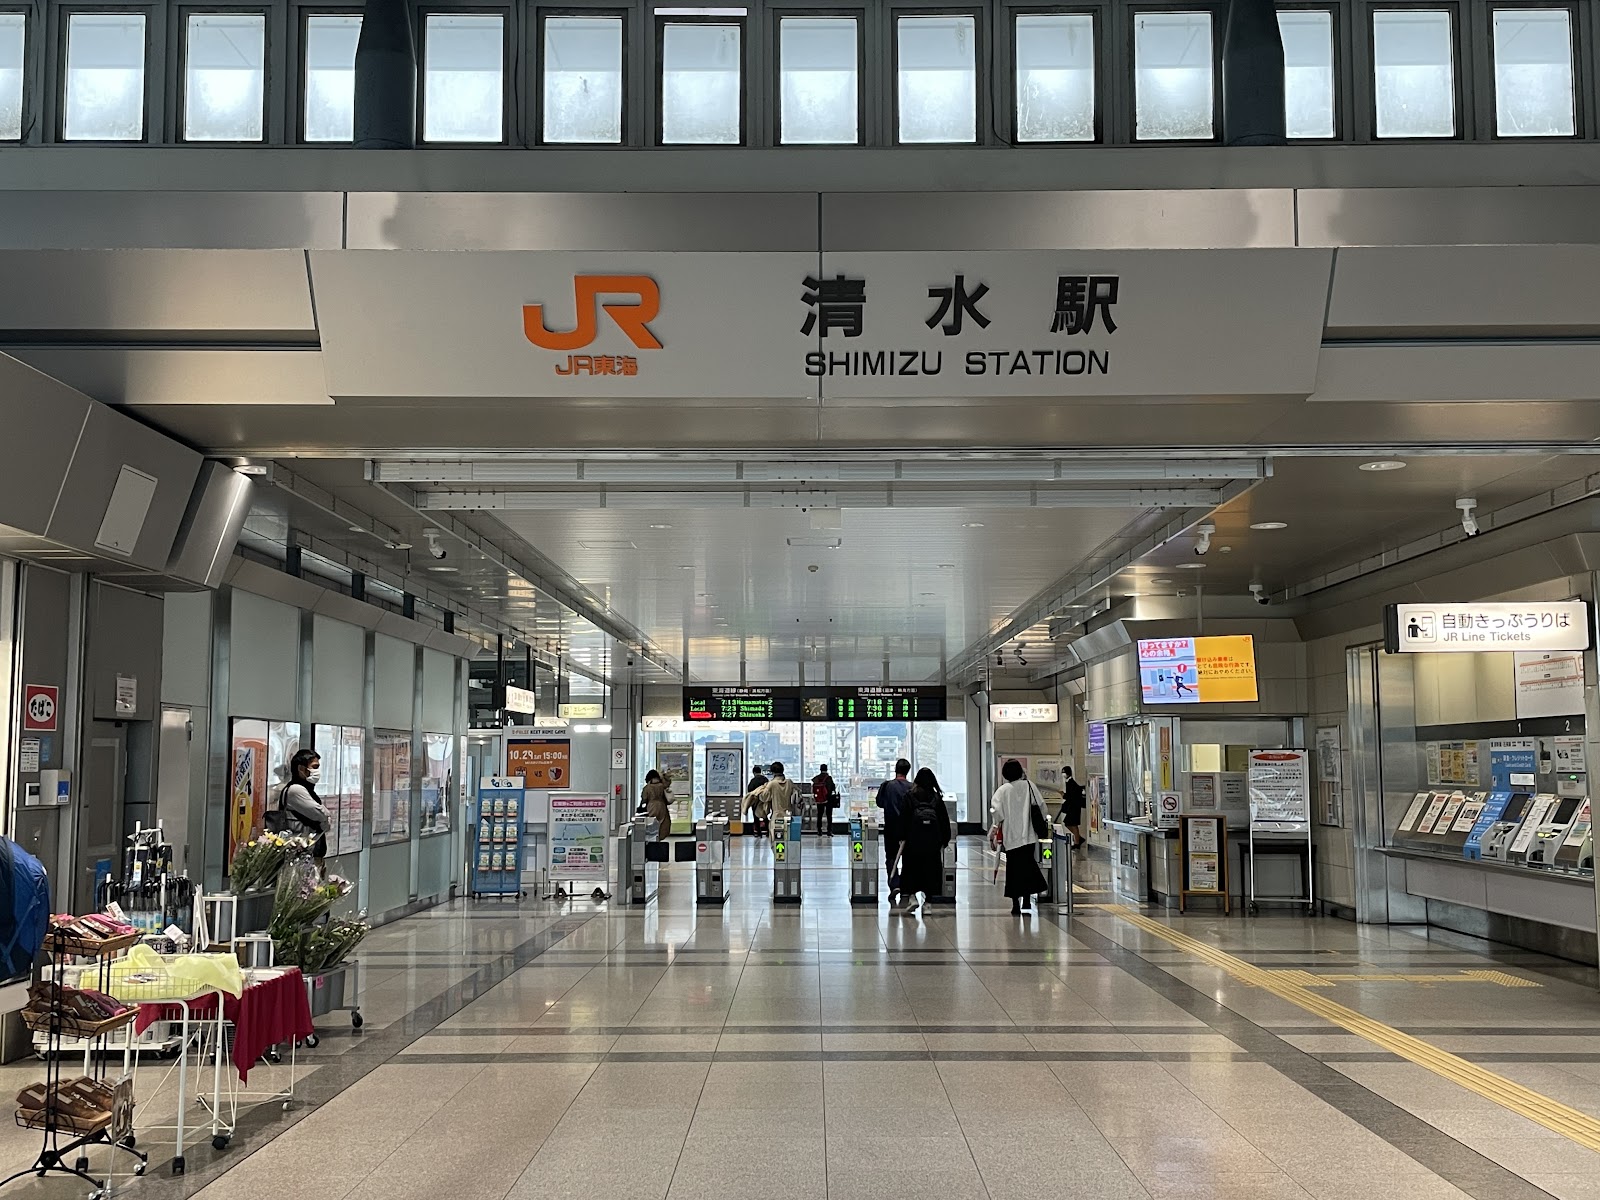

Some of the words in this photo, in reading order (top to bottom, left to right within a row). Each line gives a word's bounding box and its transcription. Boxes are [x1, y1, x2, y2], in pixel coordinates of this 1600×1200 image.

[523, 275, 663, 350] JR
[800, 275, 1119, 337] 清水駅
[555, 355, 638, 376] JR東海
[805, 351, 942, 376] SHIMIZU
[965, 350, 1109, 375] STATION
[1442, 612, 1571, 629] 自動きっぷうりば
[1443, 632, 1458, 641] JR
[1462, 632, 1485, 641] Line
[1490, 631, 1531, 641] Tickets
[31, 699, 52, 717] たばこ
[1517, 722, 1521, 733] 1
[1565, 720, 1570, 732] 2
[509, 750, 533, 760] 10.29
[543, 752, 562, 760] 15:00
[712, 754, 726, 762] だっ
